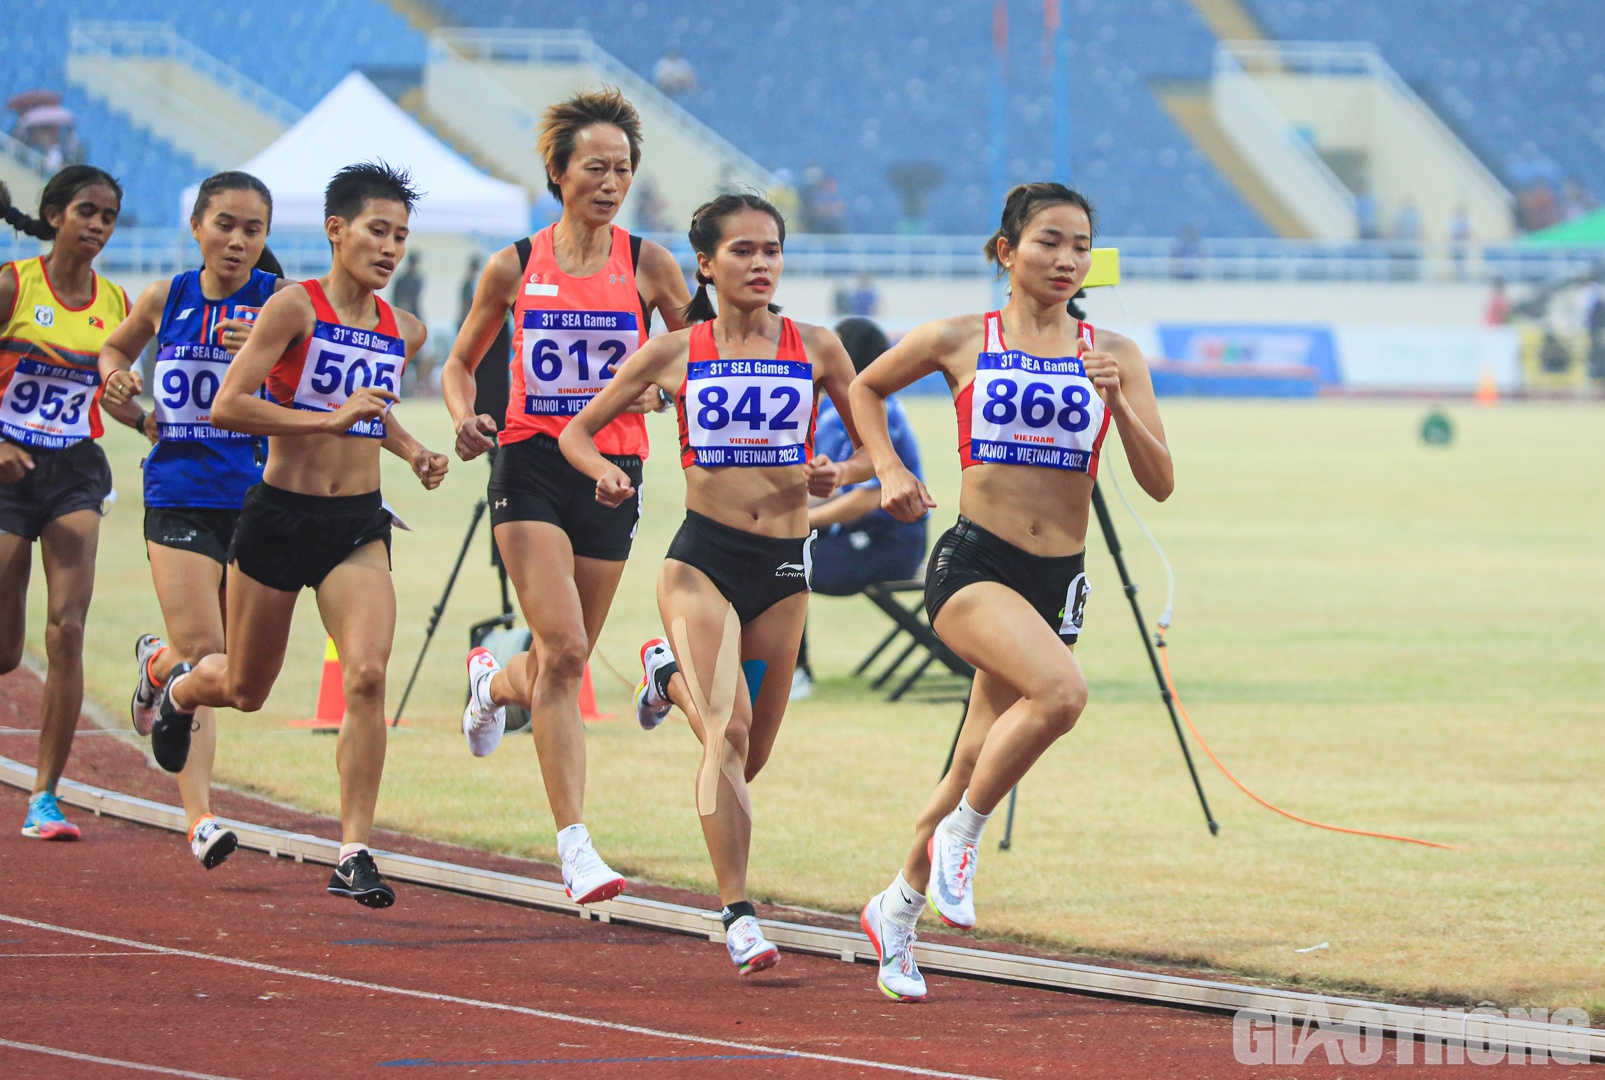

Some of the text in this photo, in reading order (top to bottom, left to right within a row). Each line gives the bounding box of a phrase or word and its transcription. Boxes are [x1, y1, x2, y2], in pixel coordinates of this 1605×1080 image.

[562, 314, 581, 327] SEA
[584, 314, 617, 328] Games
[351, 331, 370, 347] SEA
[371, 335, 389, 351] Games
[192, 346, 210, 359] SEA
[532, 338, 627, 382] 612
[710, 362, 790, 375] 31ST SEA Games
[1001, 353, 1080, 374] 31ST SEA Games
[51, 367, 66, 378] SEA
[68, 370, 94, 385] Games
[311, 349, 396, 404] 505
[162, 368, 220, 409] 90
[10, 380, 87, 425] 953
[532, 399, 559, 412] HANOI
[567, 399, 591, 412] VIET
[697, 385, 801, 431] 842
[982, 378, 1091, 433] 868
[2, 423, 26, 442] HANOI
[31, 432, 64, 448] VIETNAM
[163, 425, 187, 438] HANOI
[193, 426, 229, 439] VIETNAM
[729, 437, 769, 445] VIETNAM
[1013, 433, 1055, 444] VIETNAM
[733, 450, 777, 463] VIETNAM
[778, 447, 799, 463] 2022
[1017, 447, 1061, 465] VIETNAM
[1062, 452, 1083, 468] 2022
